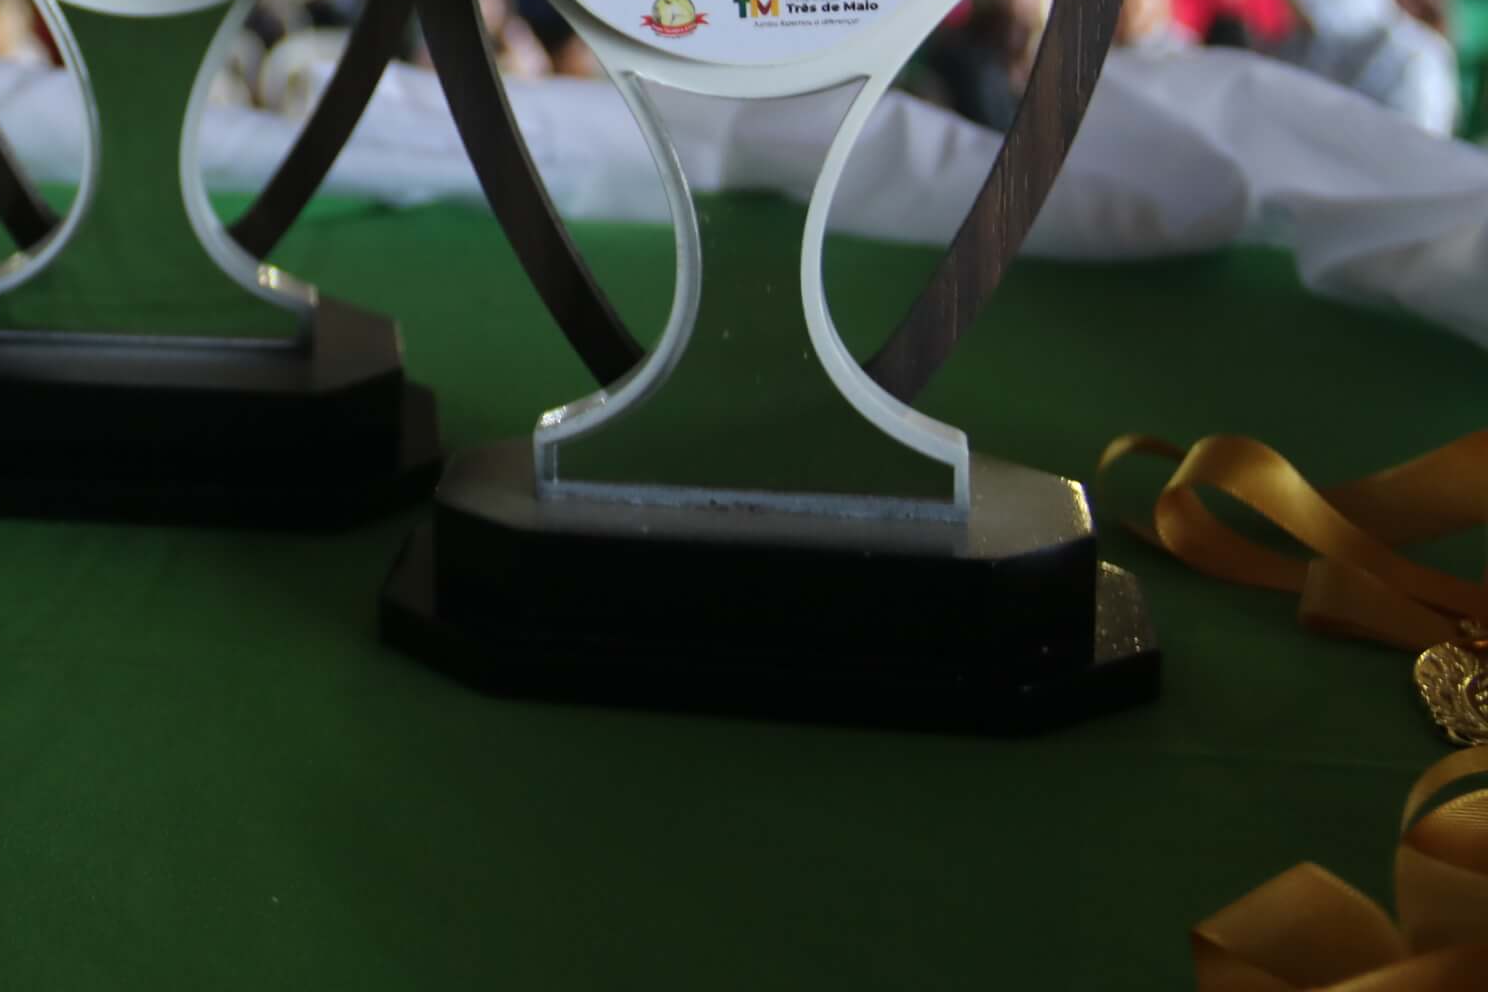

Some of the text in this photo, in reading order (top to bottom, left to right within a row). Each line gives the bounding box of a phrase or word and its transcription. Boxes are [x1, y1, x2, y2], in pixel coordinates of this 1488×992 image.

[786, 0, 879, 14] Três de Maio
